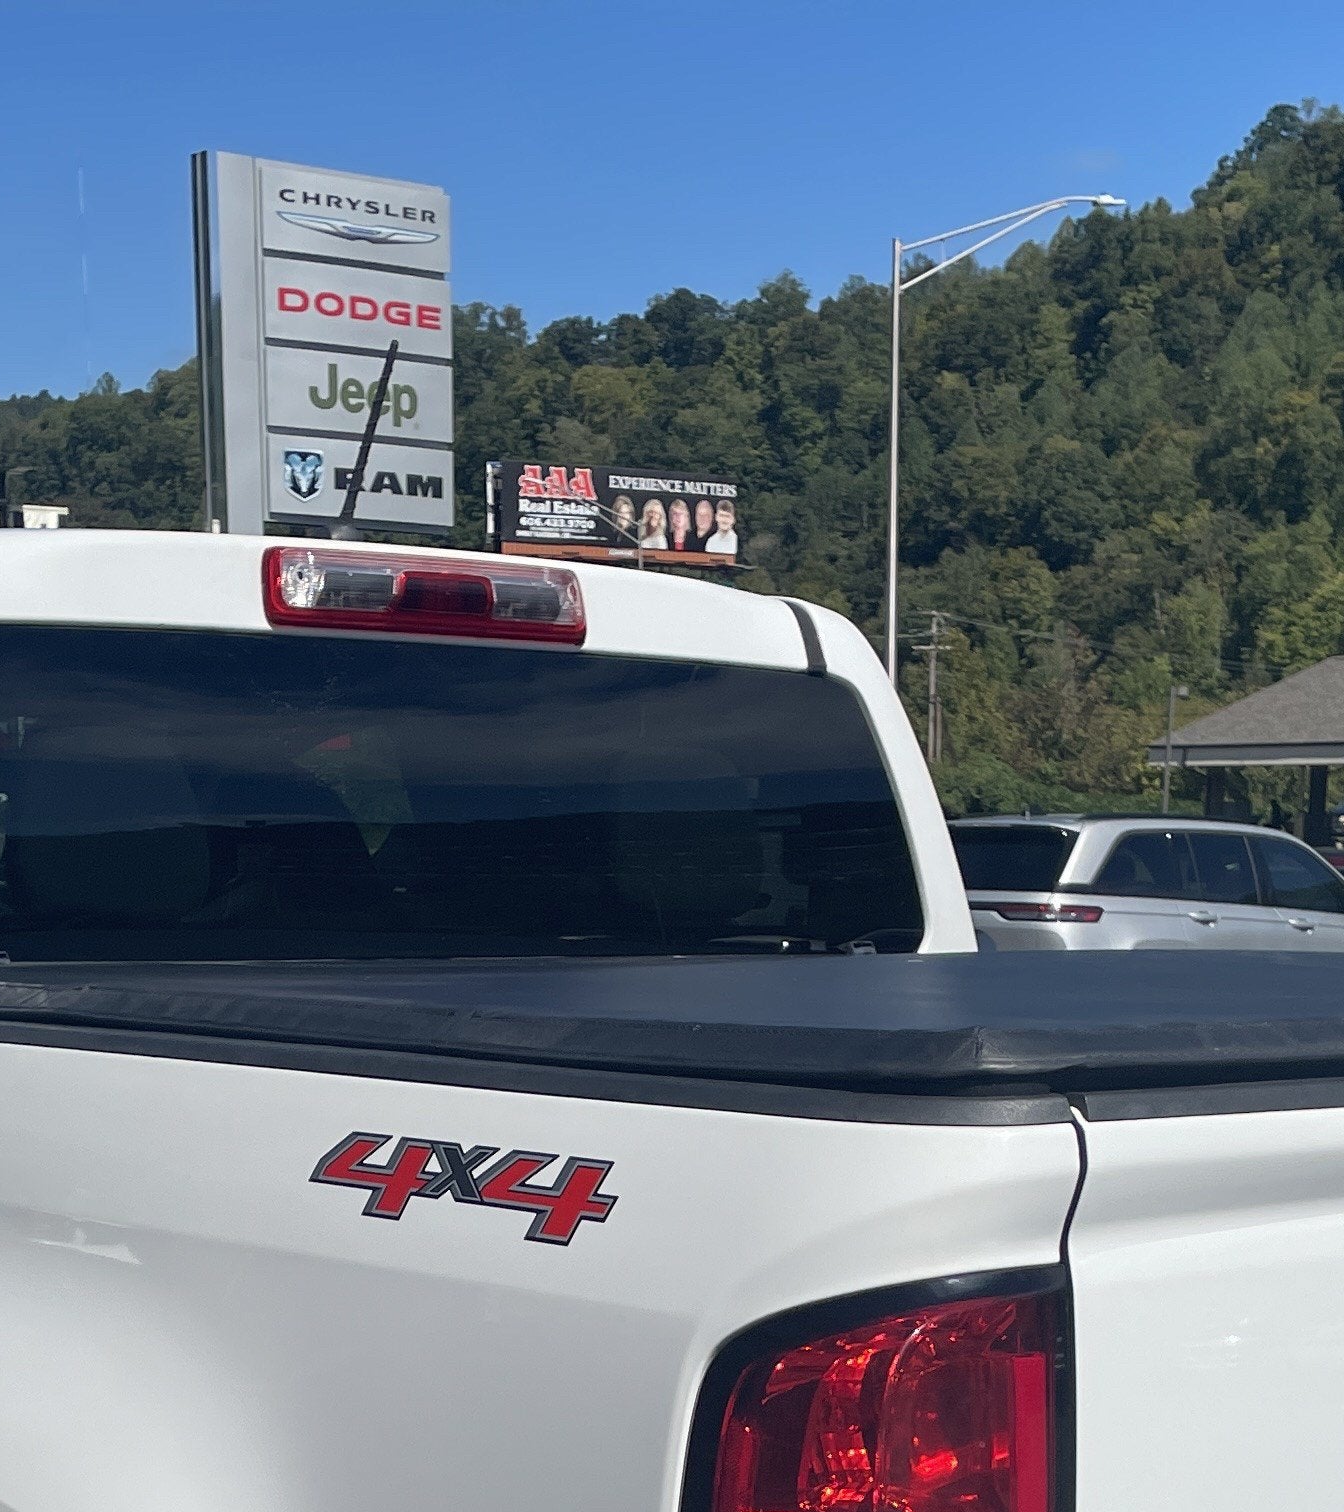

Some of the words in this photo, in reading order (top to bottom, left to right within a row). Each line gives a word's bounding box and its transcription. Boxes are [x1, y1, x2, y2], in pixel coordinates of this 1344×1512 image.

[279, 188, 437, 224] CHRYSLER
[277, 287, 442, 331] DODGE
[308, 363, 417, 427] Jeep
[334, 467, 443, 499] RAM
[518, 465, 598, 500] AAA
[608, 475, 684, 493] EXPERIENCE
[684, 481, 738, 497] MATTERS
[518, 499, 552, 513] Real
[552, 501, 600, 516] Estate
